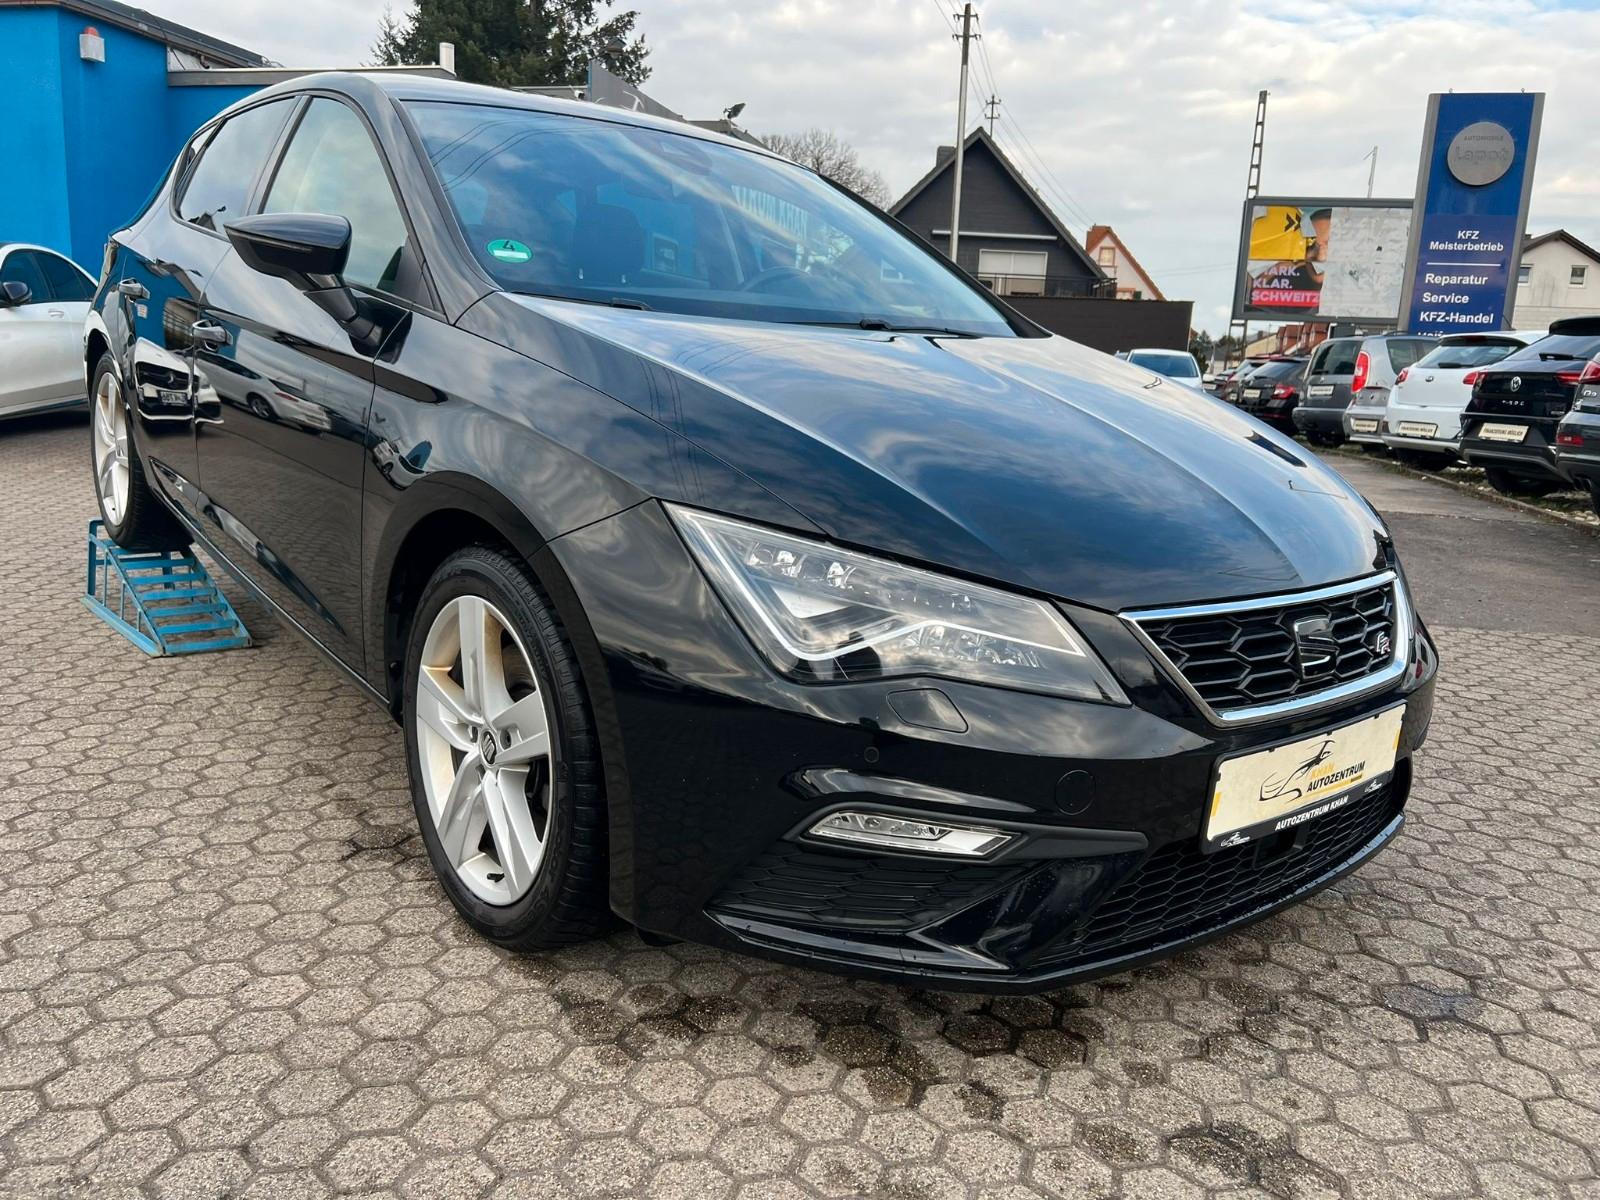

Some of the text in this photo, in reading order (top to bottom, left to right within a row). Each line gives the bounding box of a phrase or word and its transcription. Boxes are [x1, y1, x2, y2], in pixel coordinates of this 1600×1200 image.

[1457, 230, 1480, 240] KFZ
[1429, 241, 1504, 252] Meisterbetrieb
[1253, 276, 1292, 289] KLAR.
[1425, 273, 1488, 286] Reparatur
[1422, 292, 1469, 304] Service
[1420, 311, 1494, 324] KFZ-Handel
[1306, 760, 1366, 793] AUTOZENTRUM
[1274, 795, 1350, 832] AUTOZENTRUM KHAN
